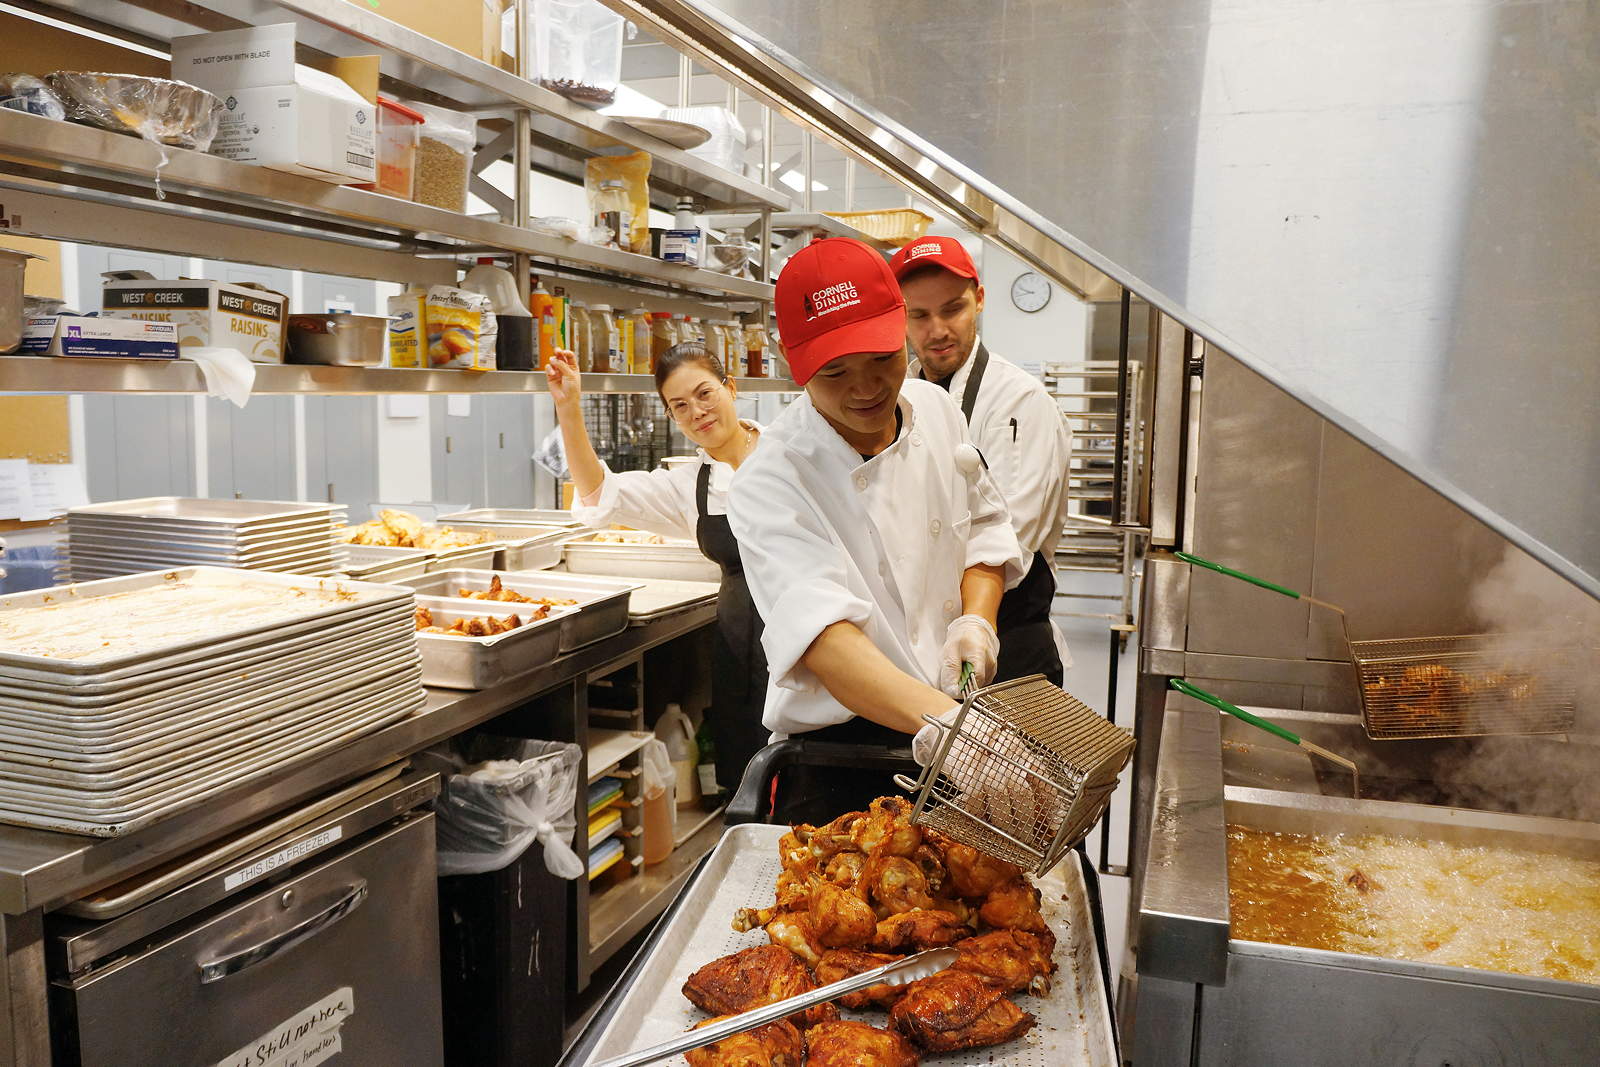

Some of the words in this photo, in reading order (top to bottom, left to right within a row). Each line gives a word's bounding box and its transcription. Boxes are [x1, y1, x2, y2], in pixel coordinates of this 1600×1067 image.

[192, 57, 202, 65] DO
[203, 56, 215, 64] NOT
[216, 54, 233, 63] OPEN
[234, 53, 249, 61] WITH
[250, 51, 271, 59] BLADE
[121, 292, 144, 304] WEST
[154, 292, 184, 304] CREEK
[812, 280, 856, 301] CORNELL
[815, 289, 858, 310] DINING
[221, 295, 245, 309] WEST
[252, 302, 277, 316] CREEK
[69, 329, 81, 338] XL
[230, 317, 269, 338] RAISINS
[239, 862, 263, 882] THIS
[265, 860, 276, 871] IS
[277, 854, 285, 865] A
[286, 832, 330, 860] FREEZER
[256, 1030, 291, 1066] Still
[294, 1015, 316, 1042] not
[319, 1001, 348, 1022] here
